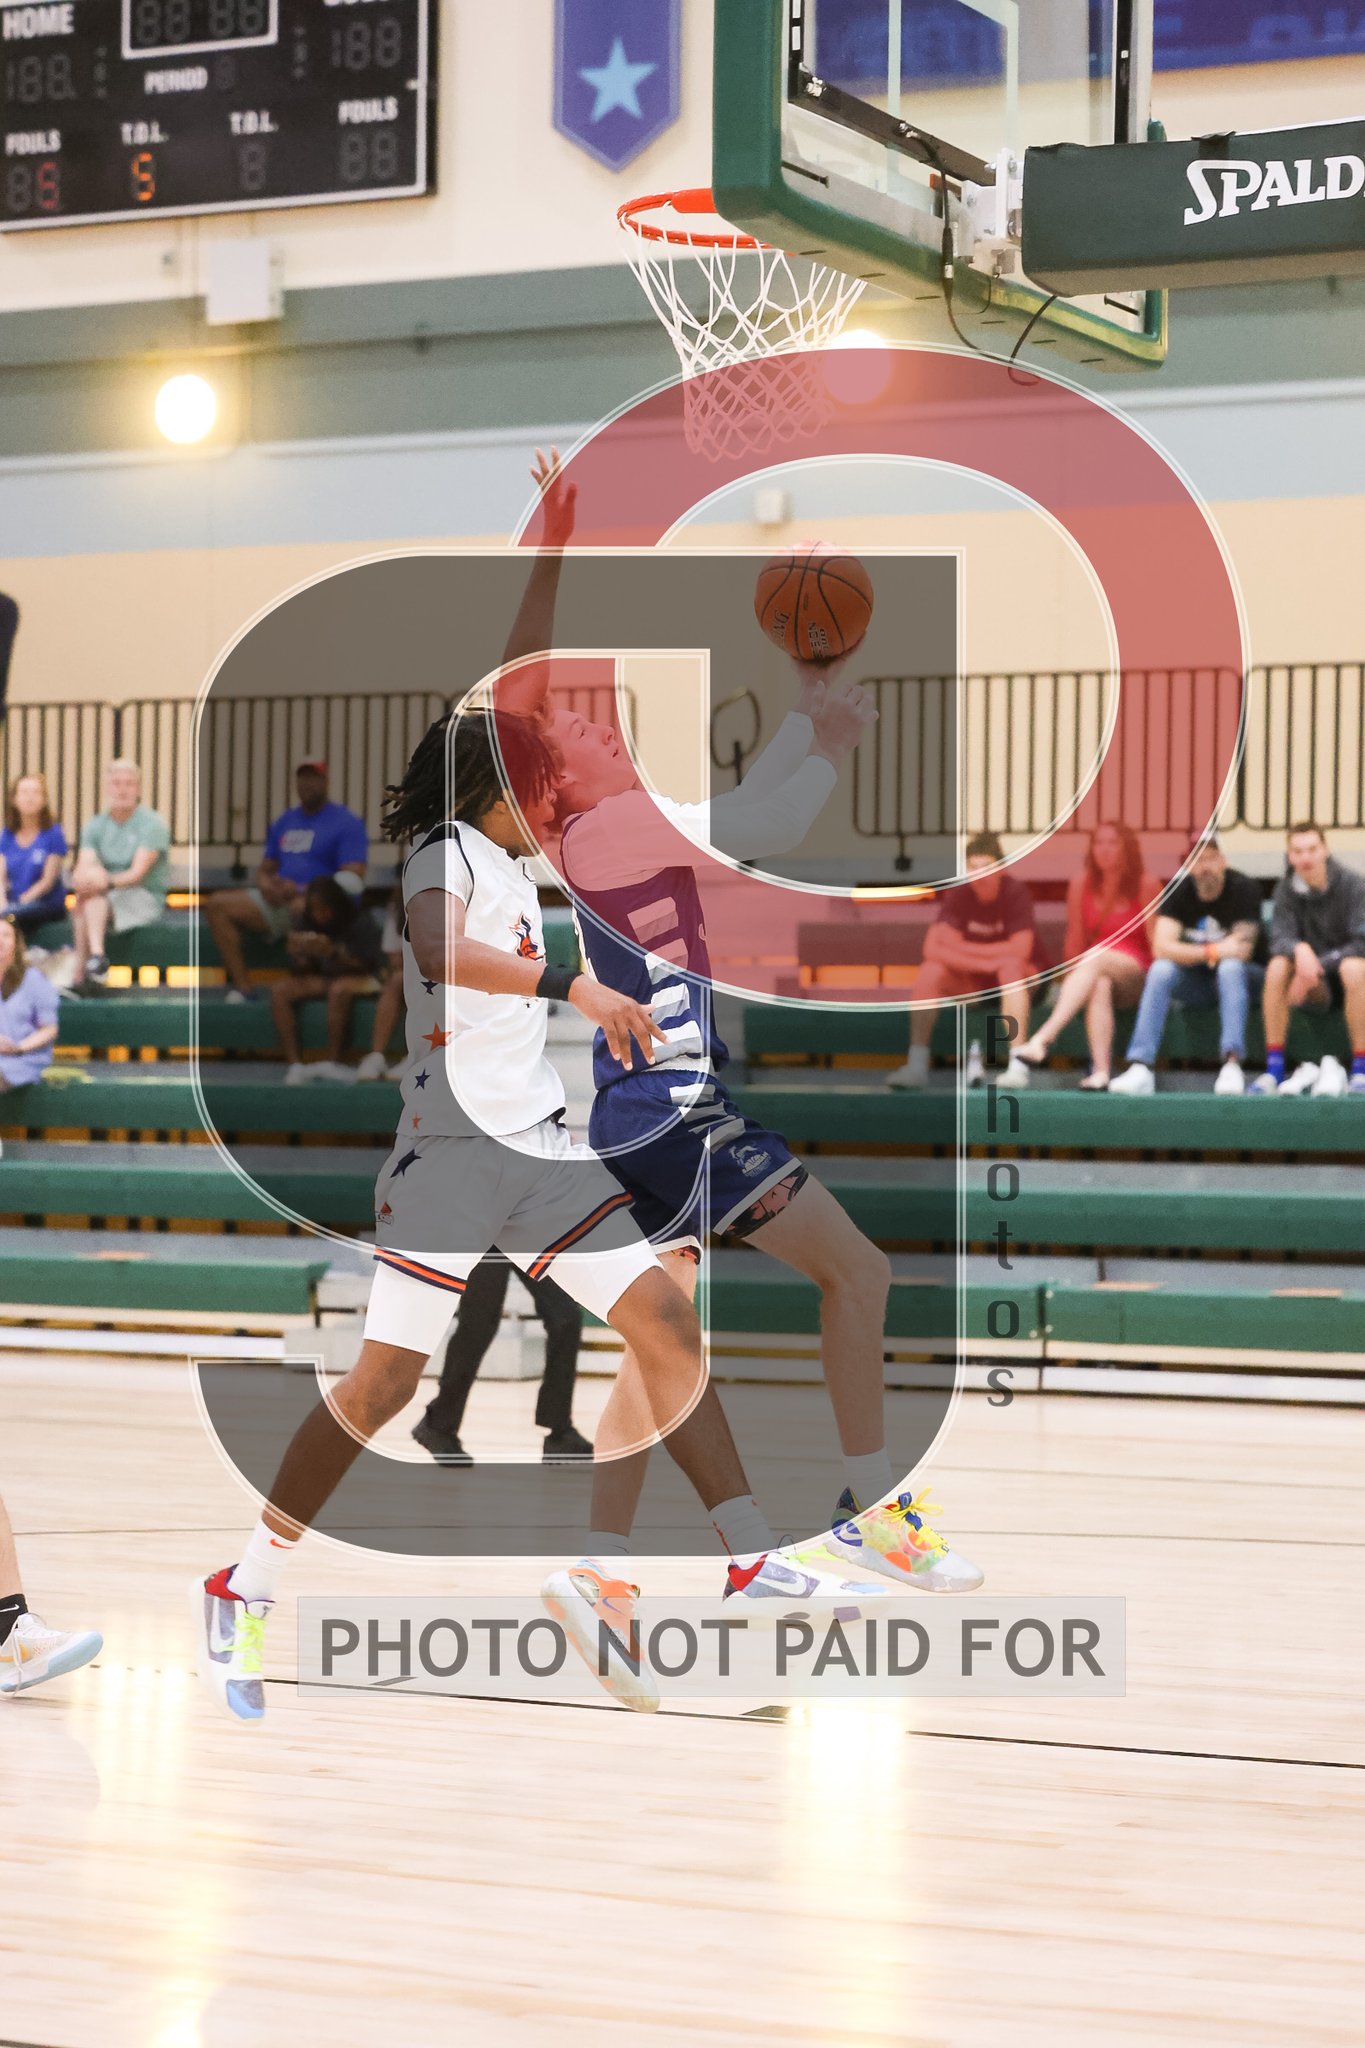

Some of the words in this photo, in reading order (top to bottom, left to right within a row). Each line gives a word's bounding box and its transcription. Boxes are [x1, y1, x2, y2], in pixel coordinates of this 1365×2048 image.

[3, 3, 75, 42] HOME
[144, 65, 208, 95] PERIOD
[338, 96, 398, 125] FOULS
[5, 128, 62, 157] FOULS
[1183, 154, 1365, 226] SPALD
